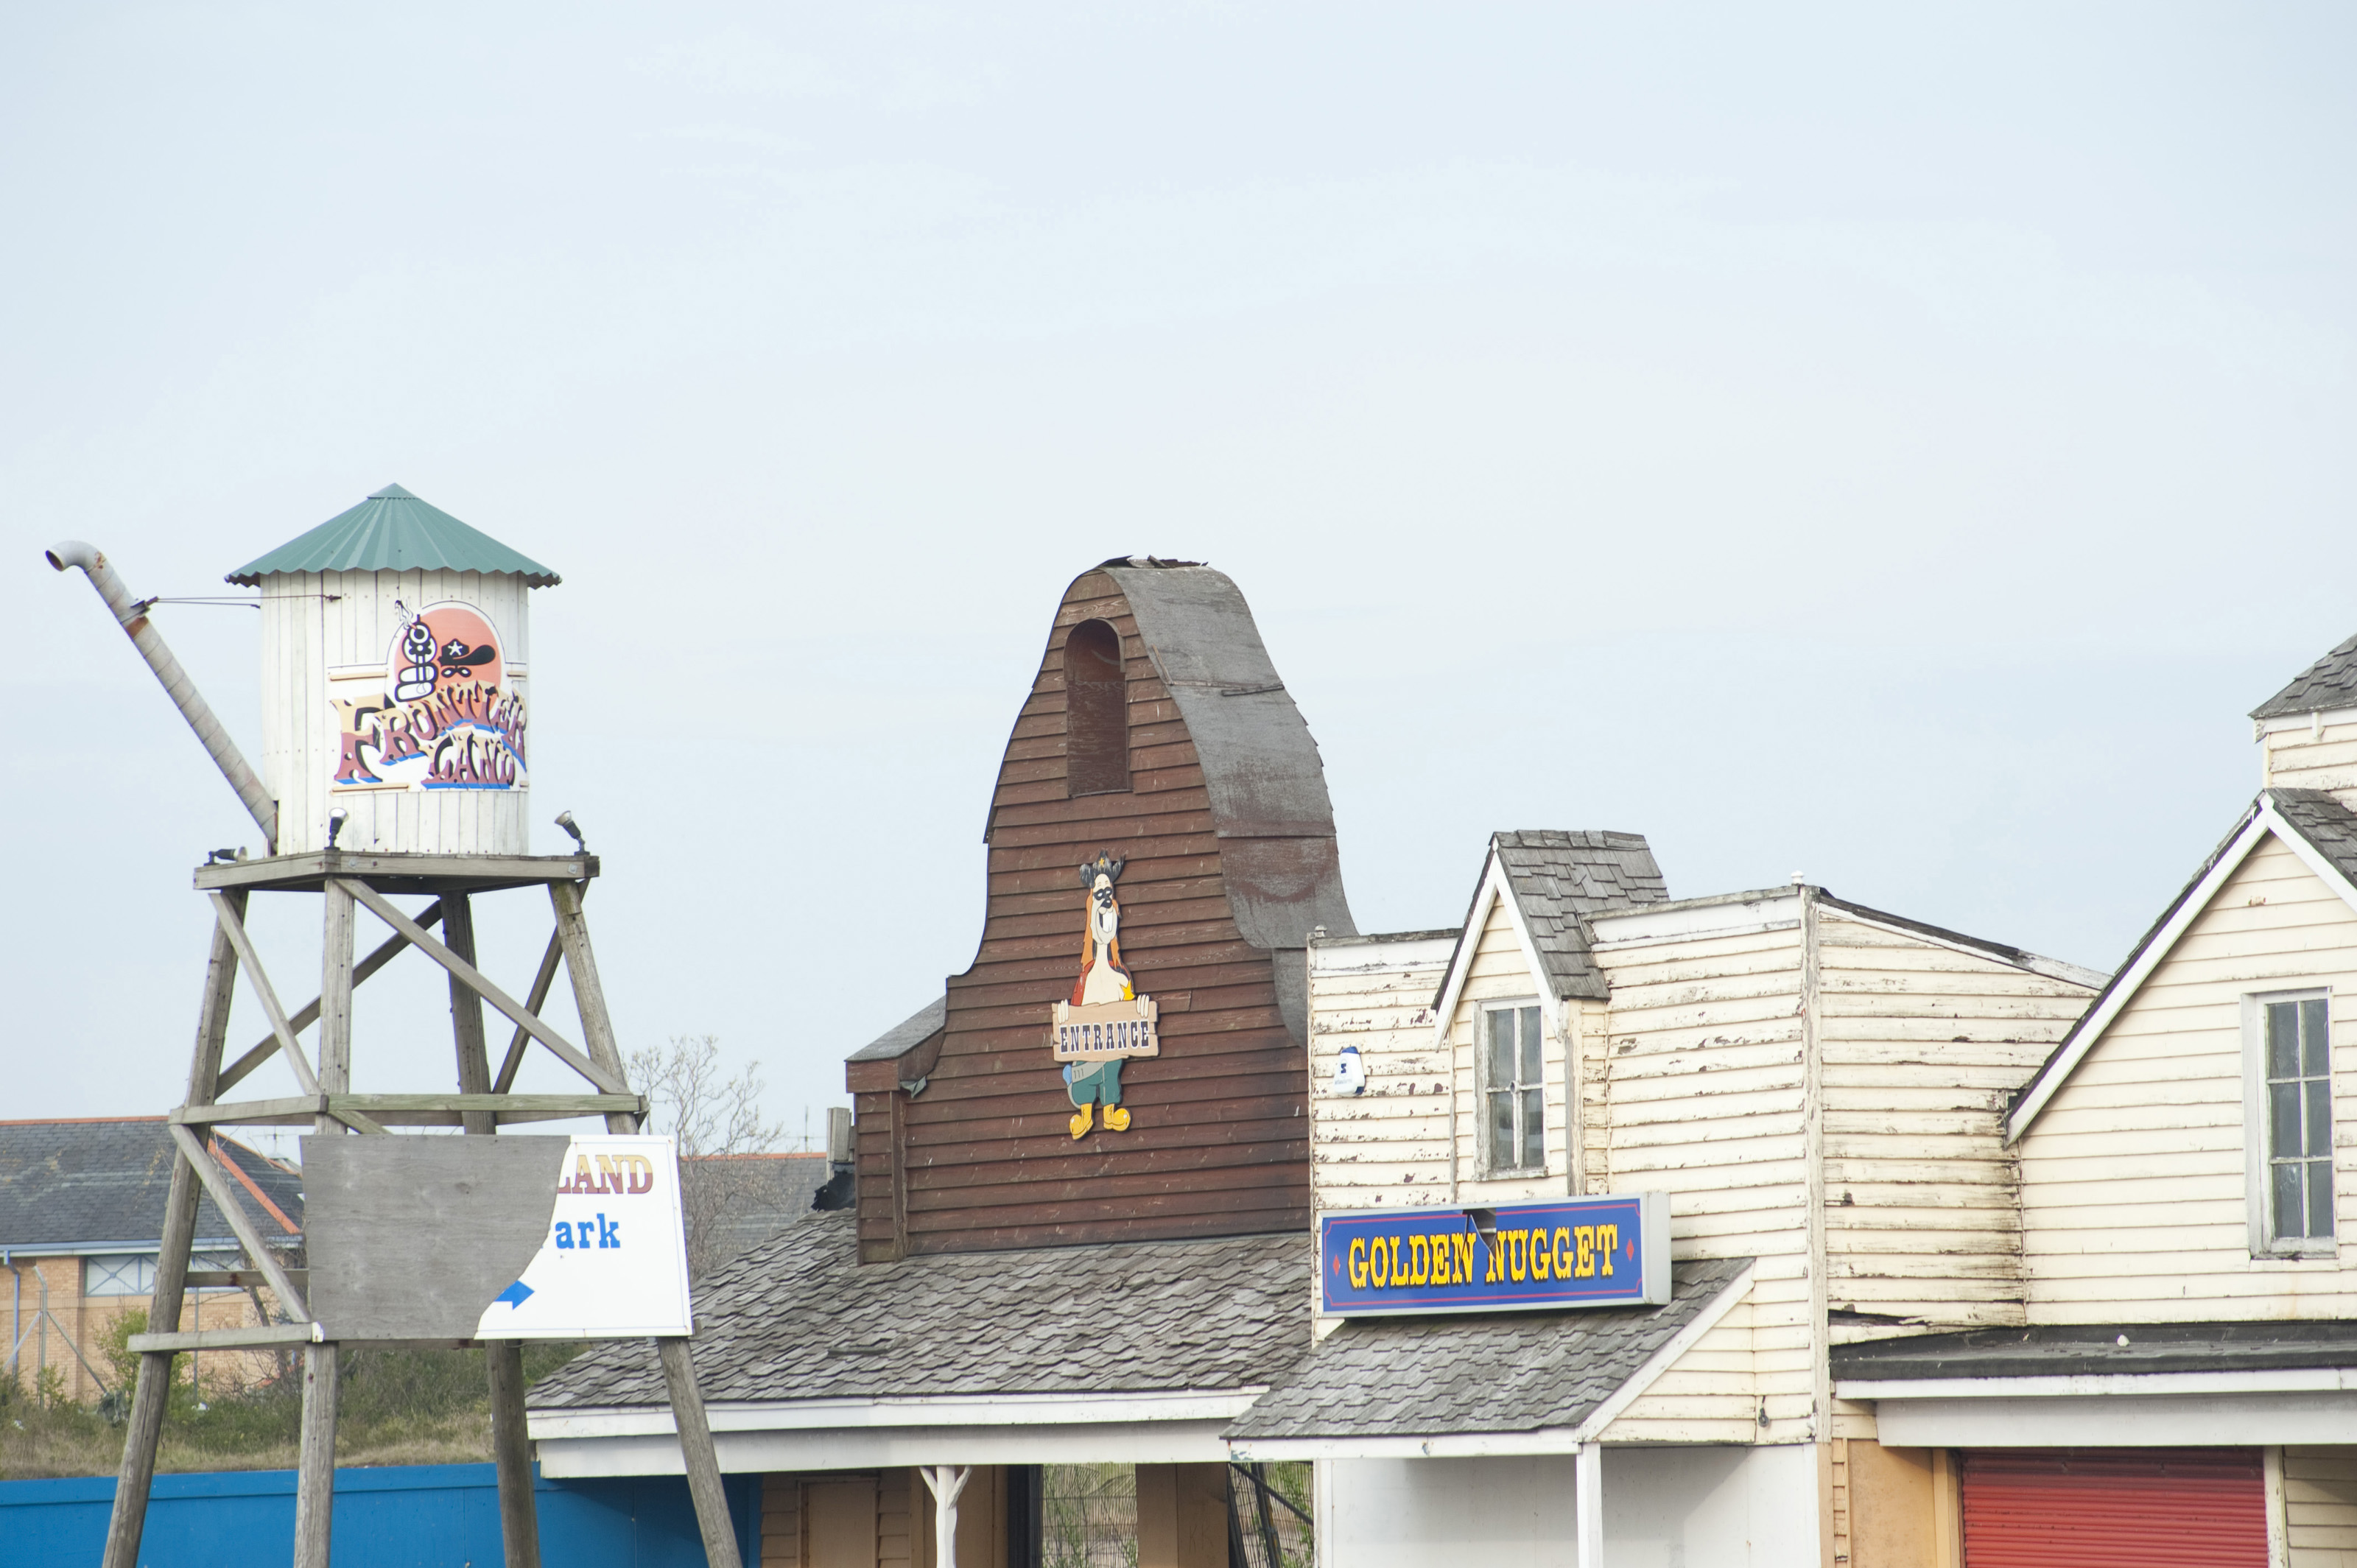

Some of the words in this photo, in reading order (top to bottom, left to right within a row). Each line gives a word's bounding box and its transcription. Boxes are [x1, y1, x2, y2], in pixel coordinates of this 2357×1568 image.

[331, 679, 527, 784] FRONTIER
[421, 731, 516, 790] LAND
[1060, 1021, 1149, 1053] ENTRANCE
[540, 1212, 621, 1249] ark
[1348, 1232, 1477, 1288] GOLDEN
[1485, 1224, 1618, 1282] NUGGET
